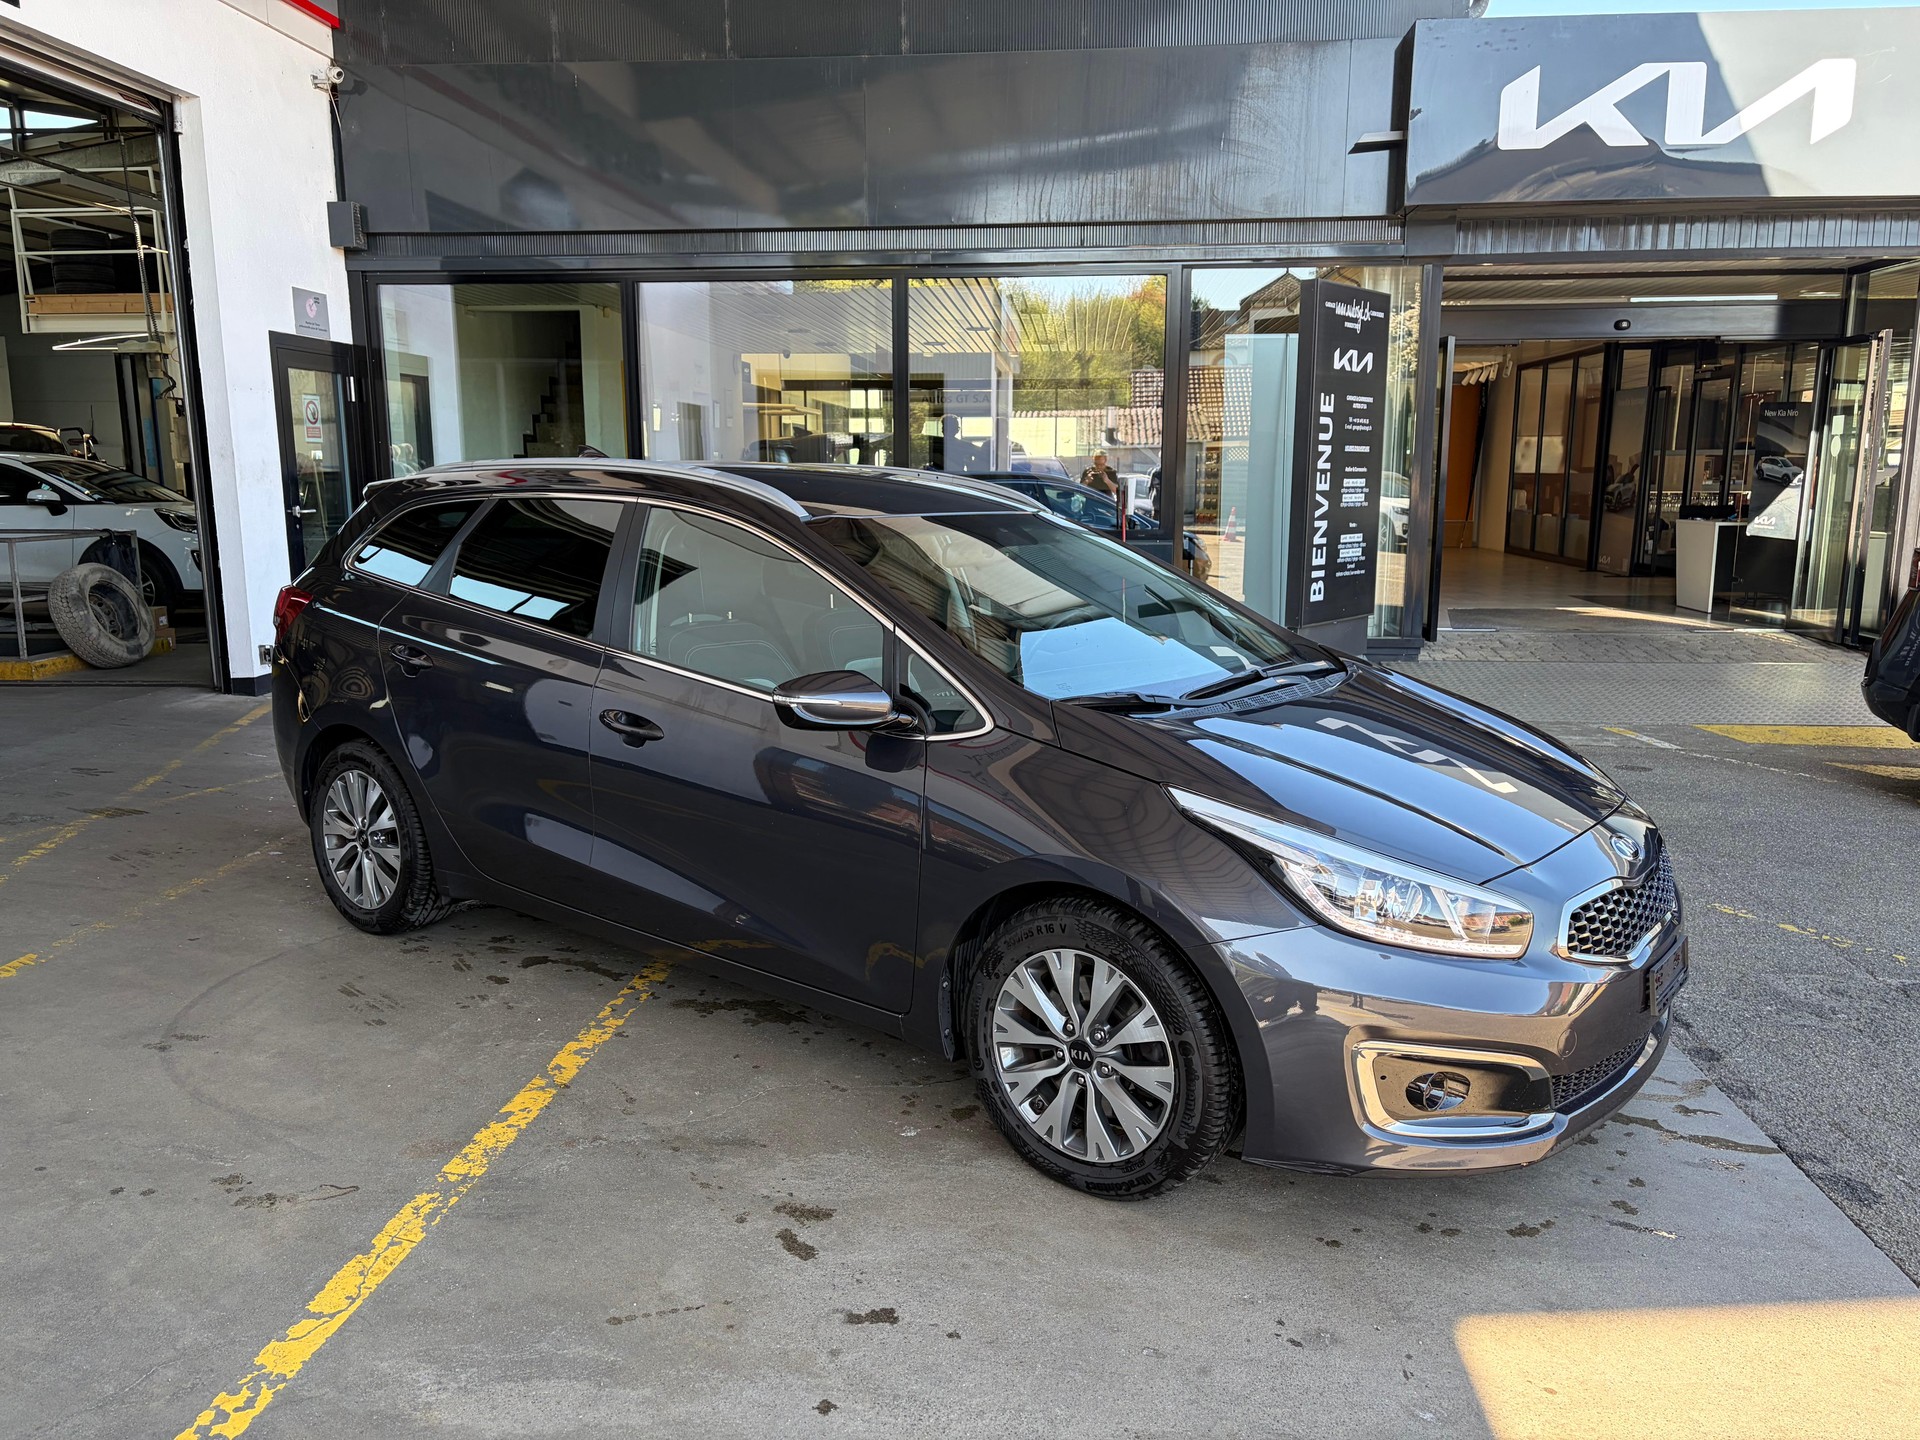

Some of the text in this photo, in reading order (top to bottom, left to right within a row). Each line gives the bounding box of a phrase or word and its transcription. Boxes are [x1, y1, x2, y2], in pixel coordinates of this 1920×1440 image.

[1498, 58, 1857, 151] KIA
[1333, 347, 1373, 374] KIA
[956, 394, 969, 403] GT
[1764, 409, 1799, 417] New Kia Niro
[1309, 392, 1335, 602] BIENVENUE
[1754, 516, 1776, 526] KIA
[1044, 923, 1055, 934] 16
[1059, 923, 1067, 934] V
[1070, 1048, 1091, 1062] KIA
